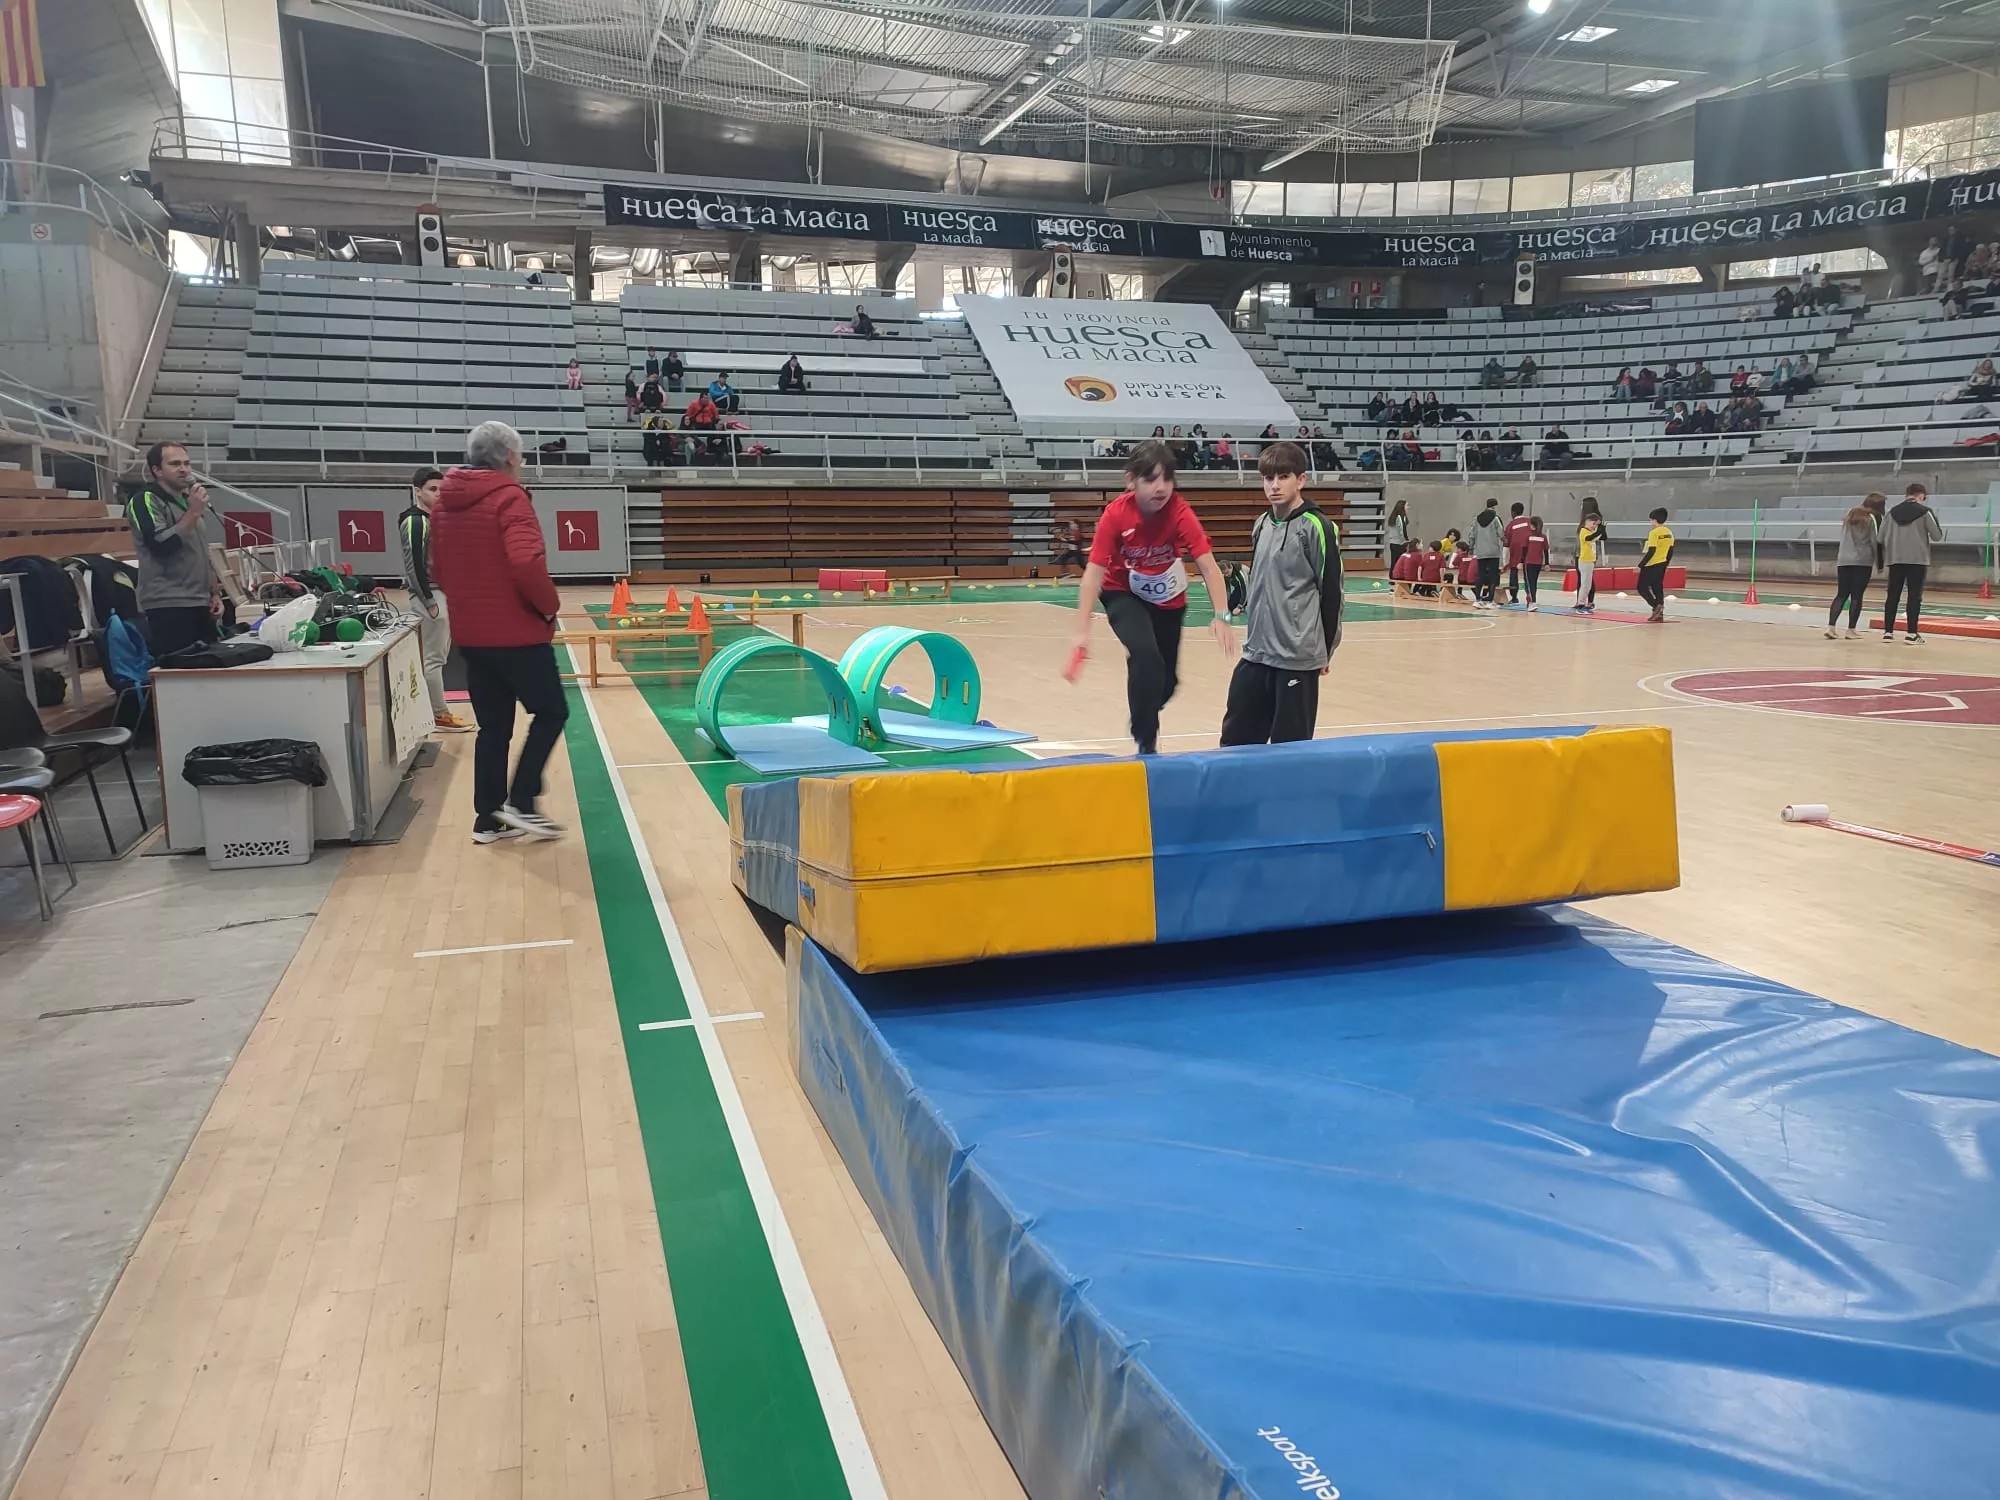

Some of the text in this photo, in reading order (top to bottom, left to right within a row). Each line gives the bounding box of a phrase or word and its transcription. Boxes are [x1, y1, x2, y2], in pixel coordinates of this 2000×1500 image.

[1948, 181, 2000, 207] Hu
[903, 210, 998, 232] Huesca
[1648, 216, 1762, 246] Huesca
[1230, 231, 1311, 248] Ayuntamiento
[1384, 235, 1476, 253] Huesca
[1518, 226, 1617, 249] Huesca
[1230, 247, 1293, 261] de Huesca
[1001, 324, 1216, 350] Huesca
[1128, 390, 1227, 400] HUESCA
[1141, 576, 1177, 595] 403
